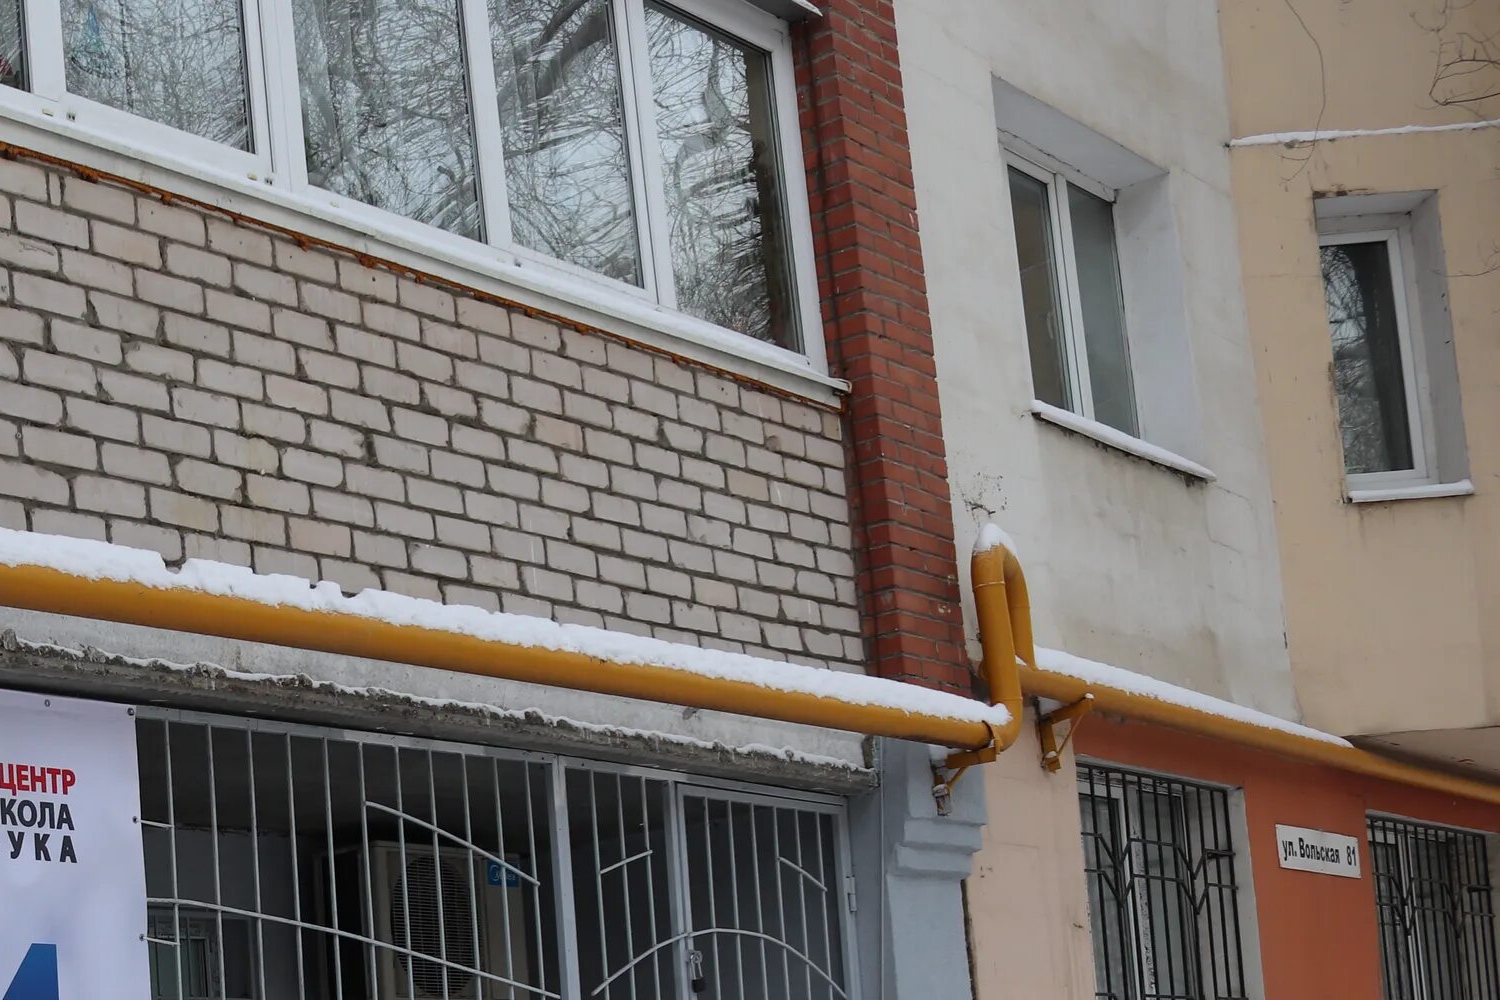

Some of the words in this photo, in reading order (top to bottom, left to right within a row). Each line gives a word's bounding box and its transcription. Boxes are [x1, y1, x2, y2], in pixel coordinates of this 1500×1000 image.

[1281, 839, 1297, 861] ул.
[1298, 837, 1341, 864] Вольская
[1346, 845, 1357, 867] 81
